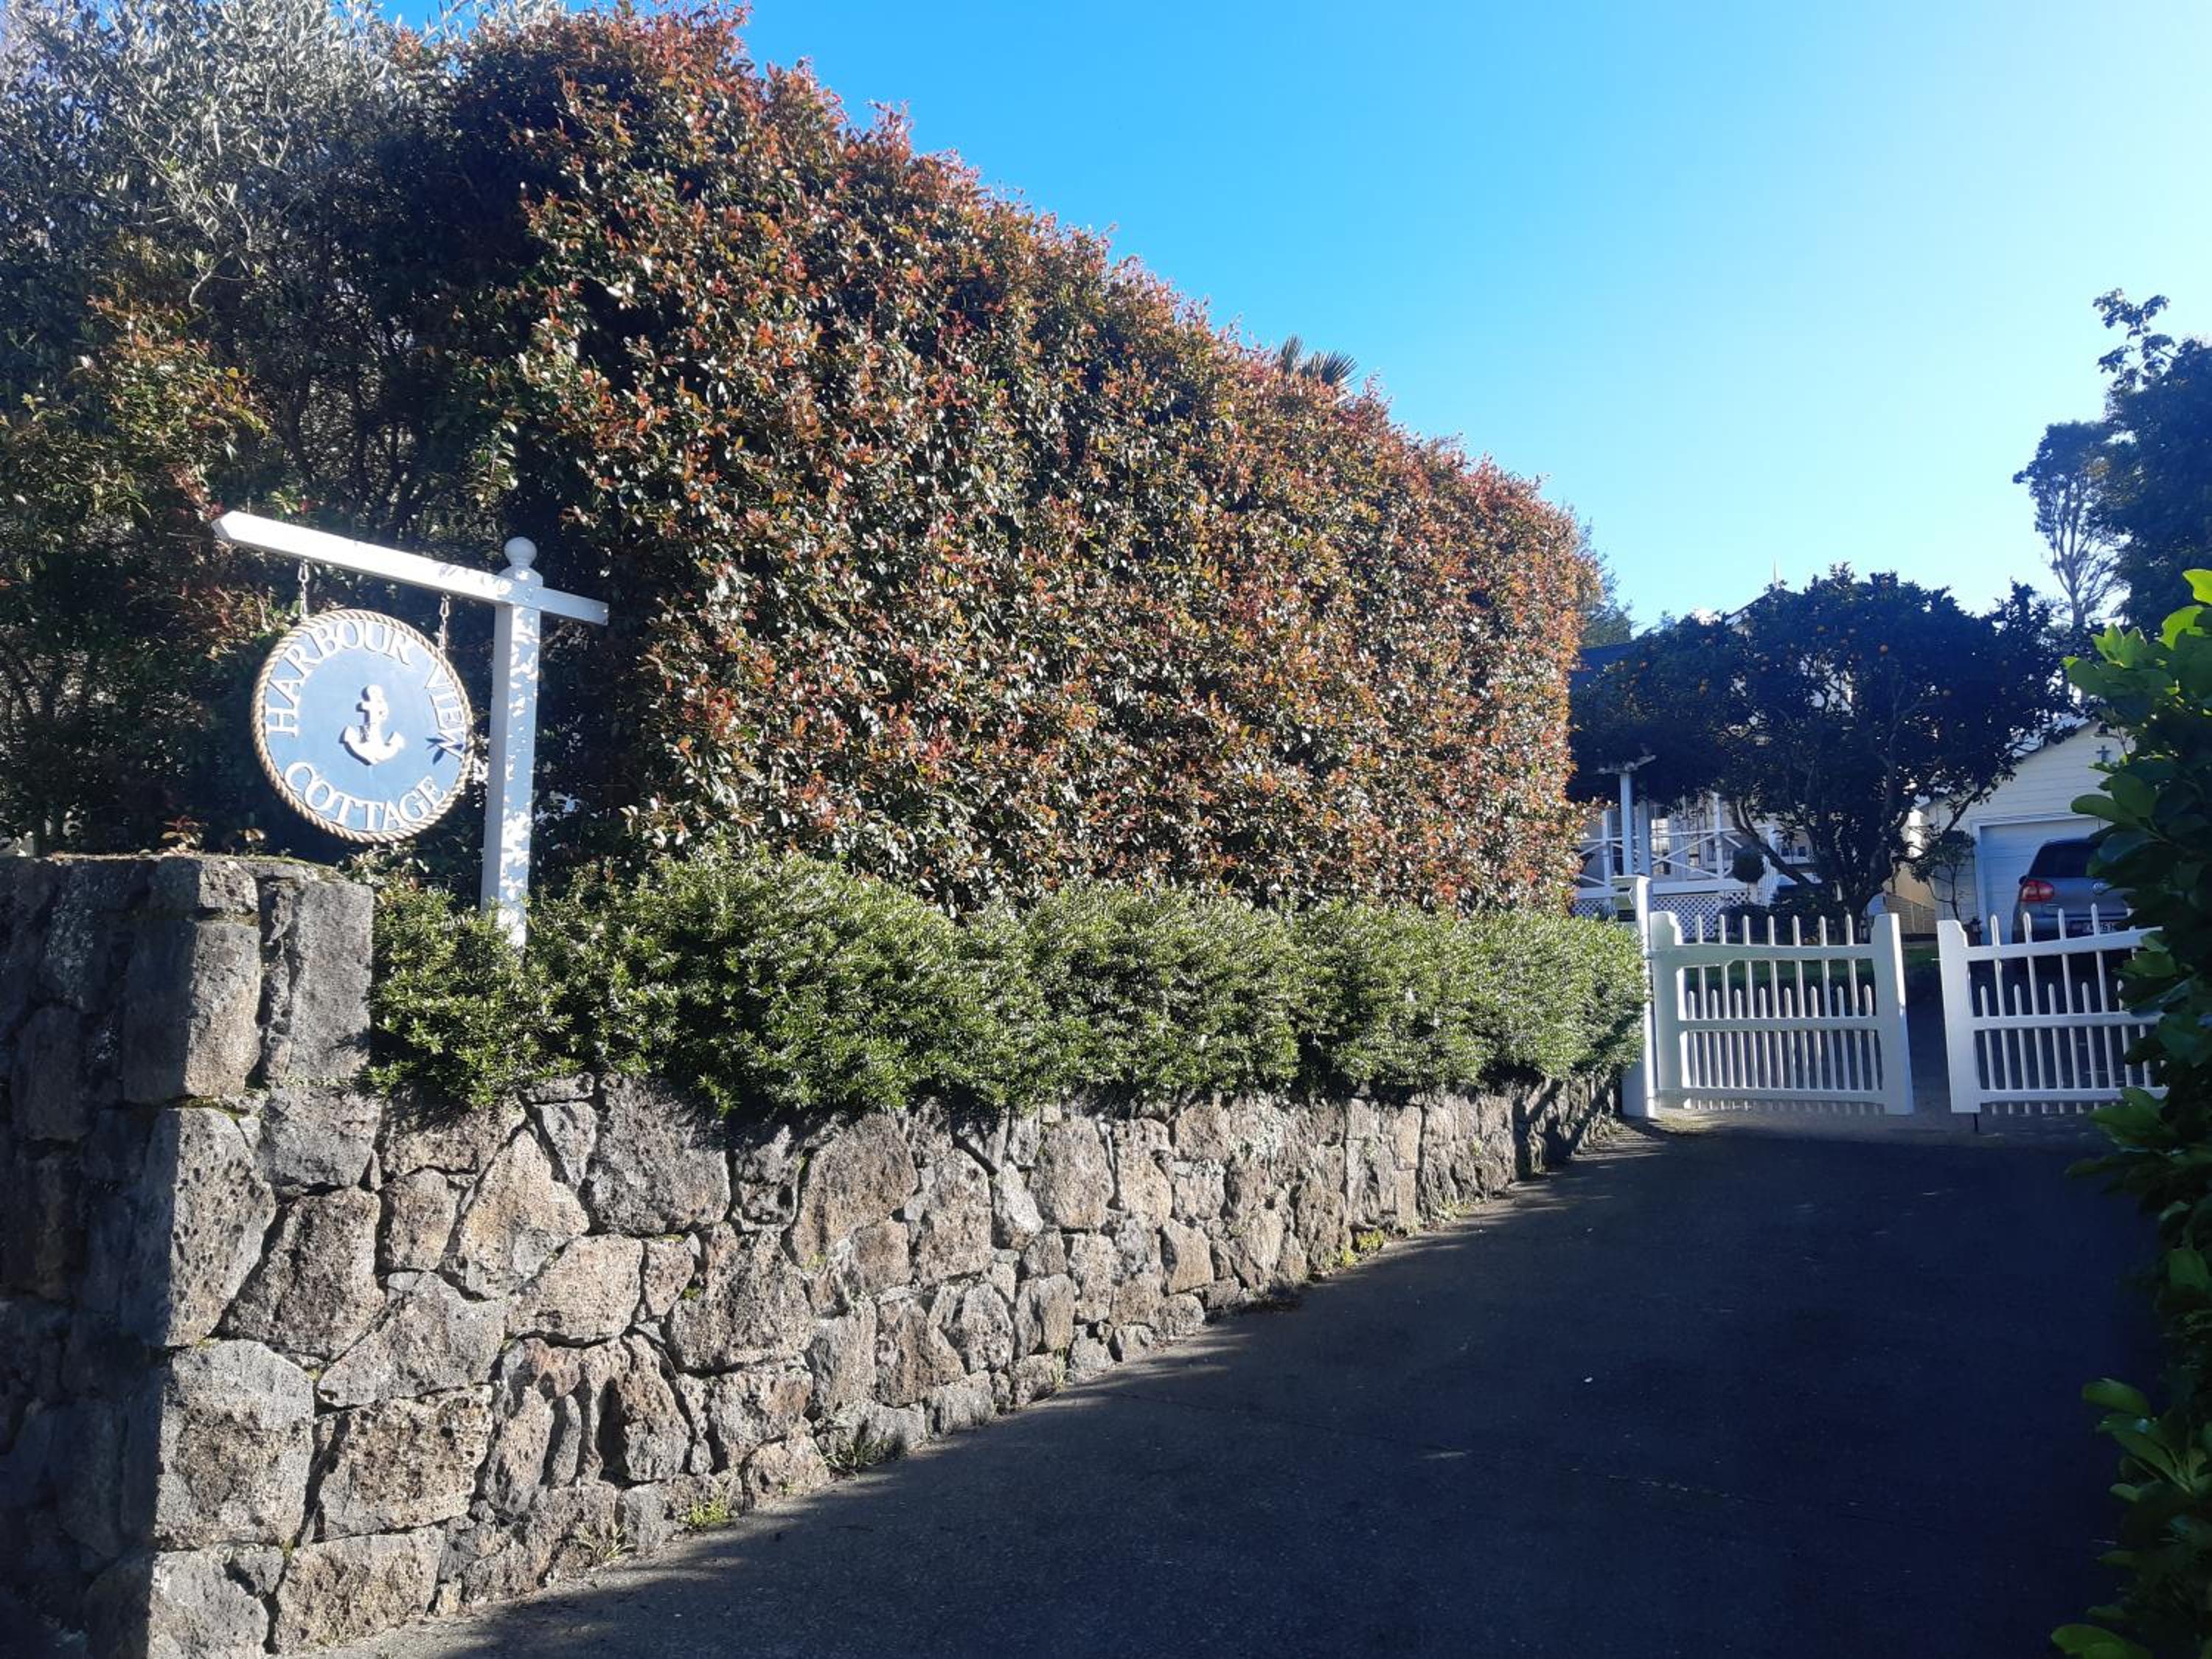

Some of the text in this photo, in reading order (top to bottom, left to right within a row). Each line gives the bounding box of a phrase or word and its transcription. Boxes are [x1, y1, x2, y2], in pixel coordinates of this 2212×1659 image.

[265, 620, 466, 760] HARBOUR VIEW
[284, 762, 445, 832] COTTAGE
